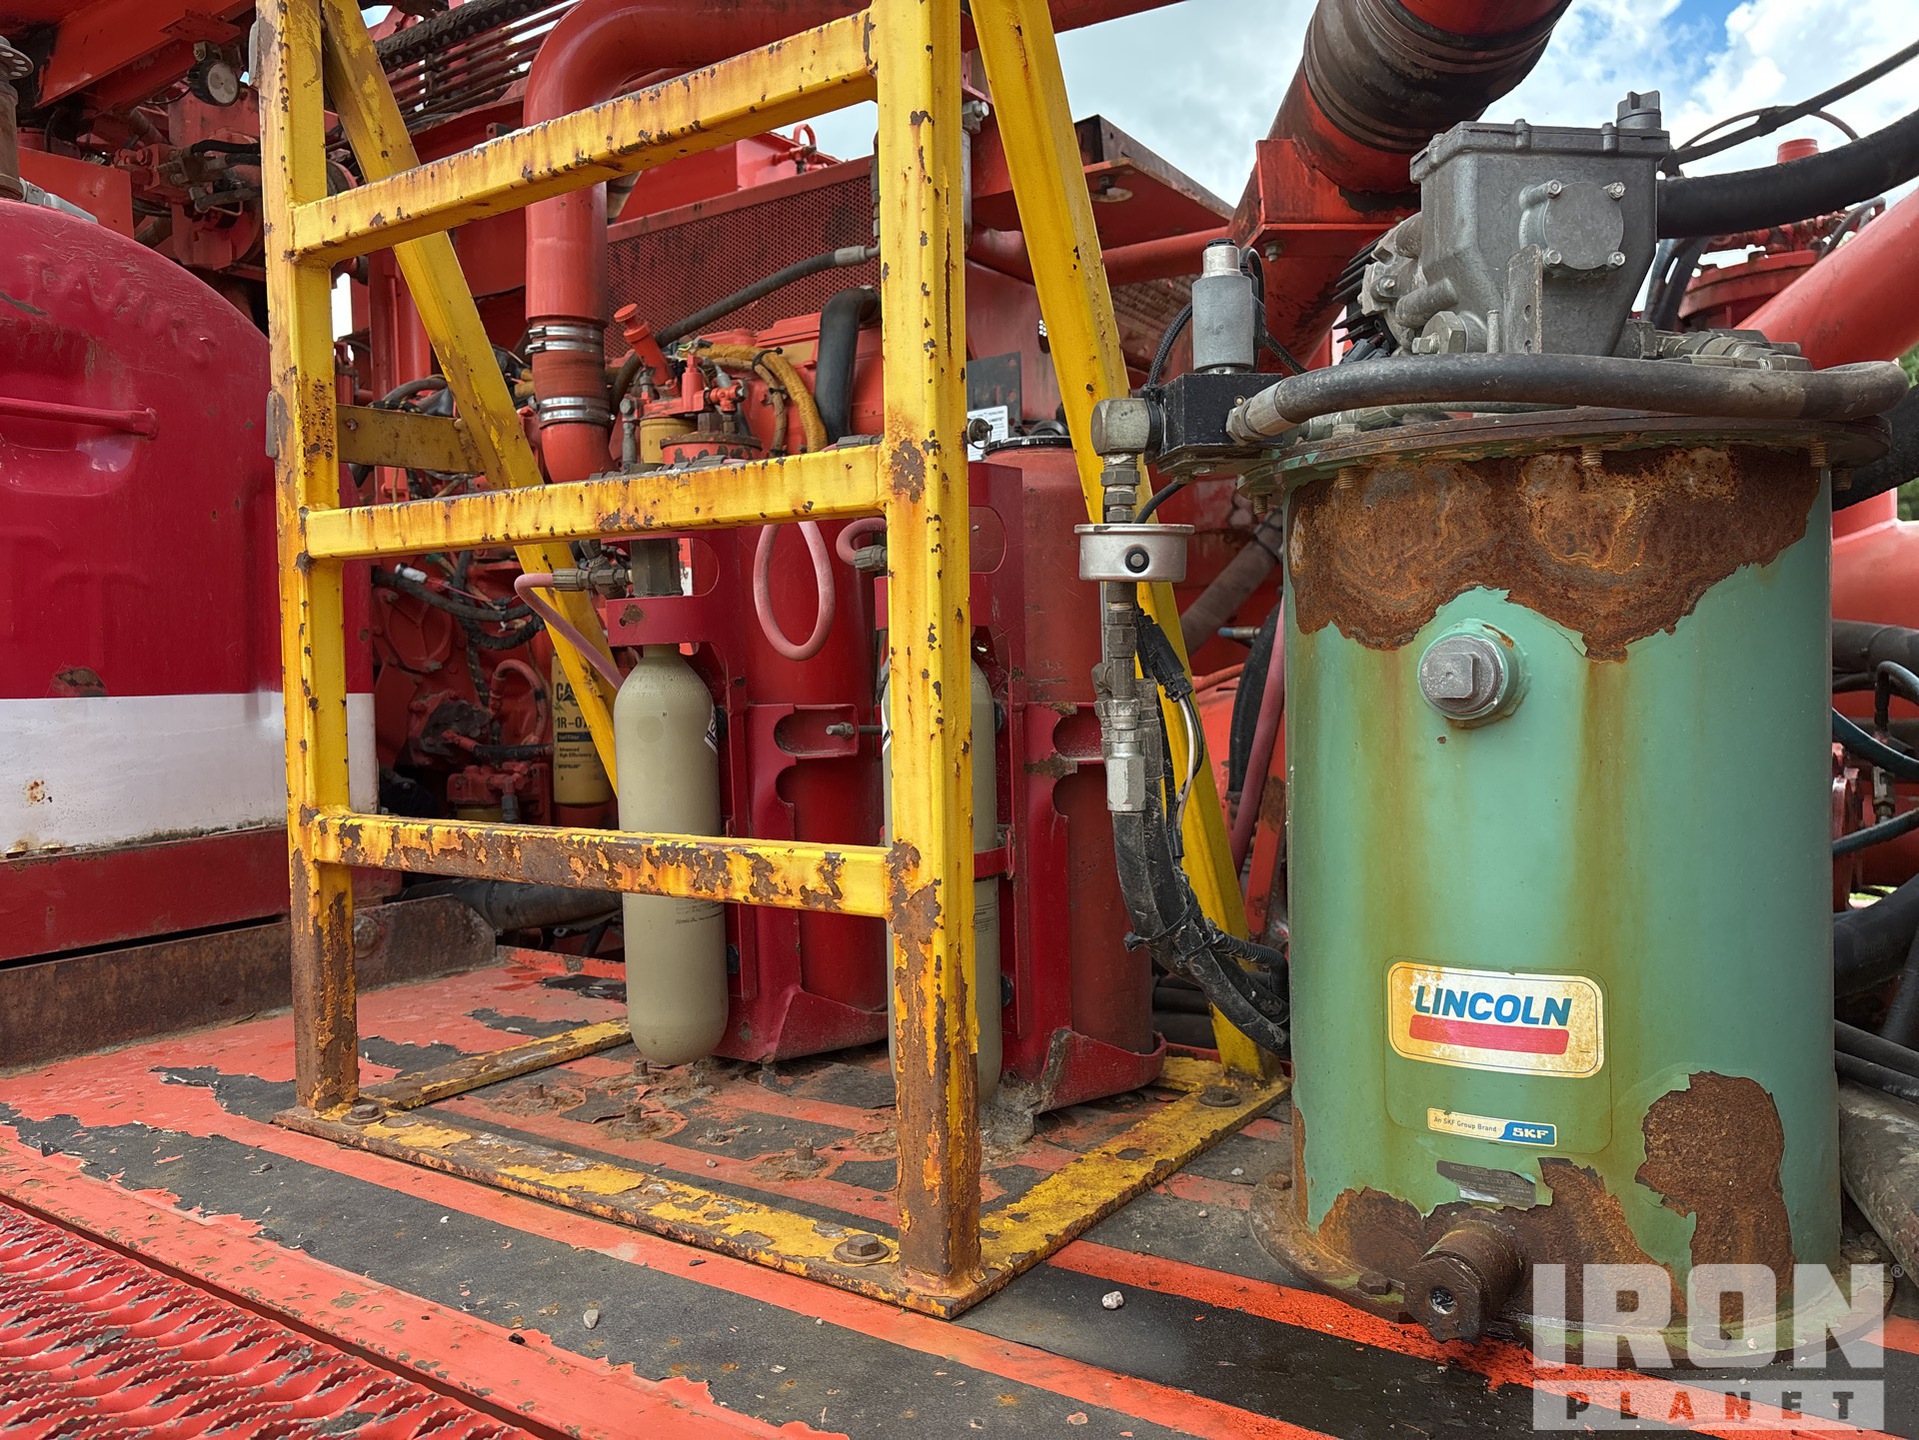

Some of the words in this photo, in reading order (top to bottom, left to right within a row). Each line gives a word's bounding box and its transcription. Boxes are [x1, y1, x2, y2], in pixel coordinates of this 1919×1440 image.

[1414, 985, 1572, 1027] LINCOLN
[1433, 1116, 1442, 1124] An
[1443, 1117, 1456, 1126] SKF
[1456, 1120, 1476, 1130] Group
[1477, 1122, 1497, 1132] Brand
[1512, 1127, 1549, 1139] SKF
